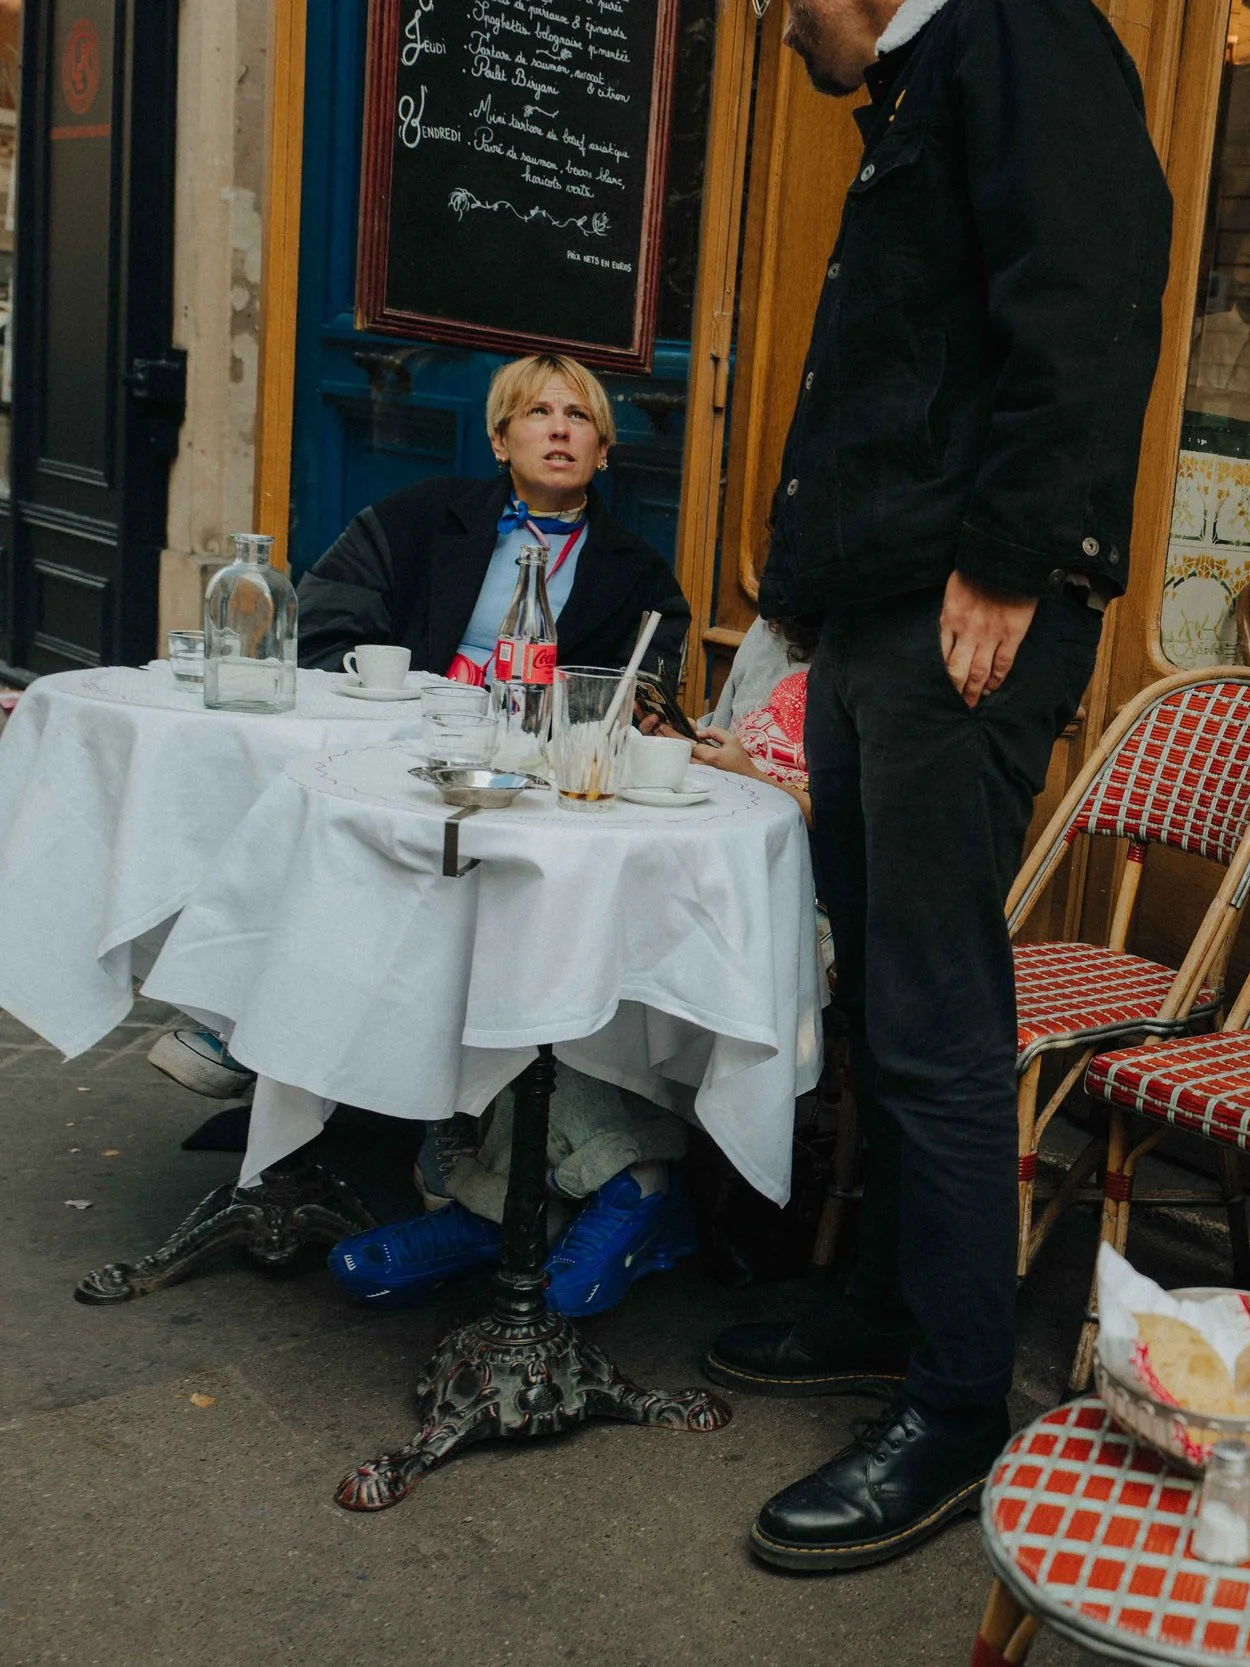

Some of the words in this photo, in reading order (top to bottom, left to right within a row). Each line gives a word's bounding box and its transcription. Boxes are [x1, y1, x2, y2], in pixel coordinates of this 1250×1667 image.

[472, 0, 531, 35] Spaghettis
[534, 21, 583, 53] bolognaise
[587, 44, 631, 63] pimentée
[528, 5, 570, 25] poireaux
[571, 15, 581, 29] &
[585, 17, 628, 40] épinards
[468, 30, 512, 61] Tartare
[514, 50, 528, 65] de
[574, 69, 605, 85] avocat
[471, 54, 508, 82] Poulet
[511, 68, 560, 100] Biryani
[586, 82, 595, 95] &
[597, 86, 631, 103] citron
[473, 93, 507, 125] Mini
[508, 113, 545, 136] tartare
[546, 128, 559, 141] de
[588, 141, 630, 164] asiatique
[473, 126, 505, 155] Pavé
[505, 144, 519, 160] de
[521, 164, 562, 190] haricots
[565, 184, 595, 198] verts
[583, 255, 600, 266] NETS
[600, 258, 610, 268] EN
